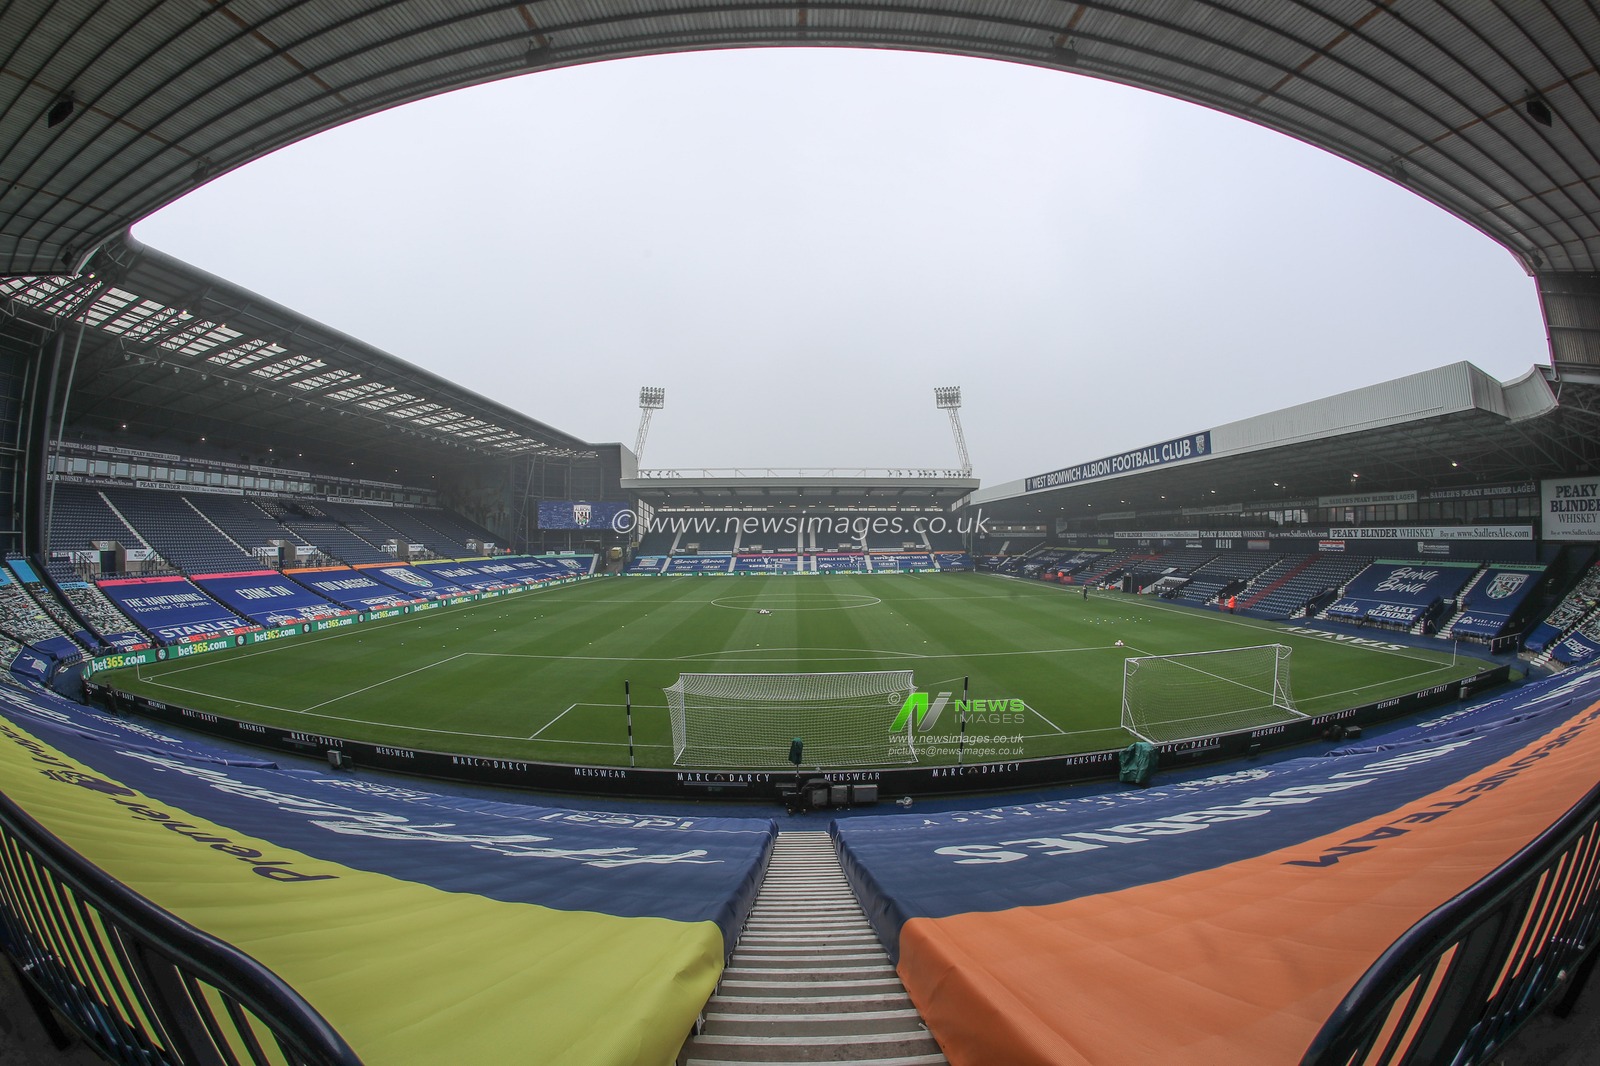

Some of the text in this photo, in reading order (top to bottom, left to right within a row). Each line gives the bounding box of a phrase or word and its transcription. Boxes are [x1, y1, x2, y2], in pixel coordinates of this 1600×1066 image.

[1032, 440, 1191, 489] WEST BROMWICH ALBION FOOTBALL CLUB
[1556, 484, 1598, 498] PEAKY
[1558, 514, 1597, 524] WHISKEY
[1243, 530, 1266, 538] WHISKEY
[1332, 529, 1359, 538] PEAKY
[1361, 529, 1398, 538] BLINDER
[1399, 528, 1436, 538] WHISKEY
[1457, 528, 1529, 538] www.SadlersAles.com
[235, 586, 295, 600] COME ON
[312, 581, 342, 592] YOU
[122, 598, 146, 608] THE
[414, 603, 439, 612] bet365.com
[1376, 604, 1419, 614] PEAKY
[133, 606, 161, 614] Home
[371, 609, 400, 620] bet365.com
[1367, 608, 1417, 620] BLINDER
[318, 617, 353, 630] bet365.com
[254, 627, 296, 642] bet365.com
[178, 640, 227, 657] bet365.com
[92, 654, 146, 673] bet365.com
[1377, 698, 1400, 710] MENSWEAR
[182, 709, 218, 724] MARC DARCY
[1312, 710, 1356, 726] MARC DARCY
[238, 722, 266, 734] MENSWEAR
[1252, 726, 1286, 738] MENSWEAR
[291, 732, 344, 748] MARC DARCY
[1158, 737, 1220, 754] ARC DARCY
[376, 746, 415, 759] MENSWEAR
[452, 756, 528, 772] MARC DARCY
[1066, 753, 1114, 766] MENSWEAR
[574, 768, 626, 779] MENSWEAR
[824, 772, 881, 781] MENSWEAR
[932, 763, 1020, 778] MARC DARCY
[1455, 752, 1549, 795] ONE
[678, 772, 770, 783] MARC DARCY
[934, 777, 1378, 865] BAGGIES
[1281, 794, 1481, 867] TEAM
[109, 797, 340, 882] Premier
